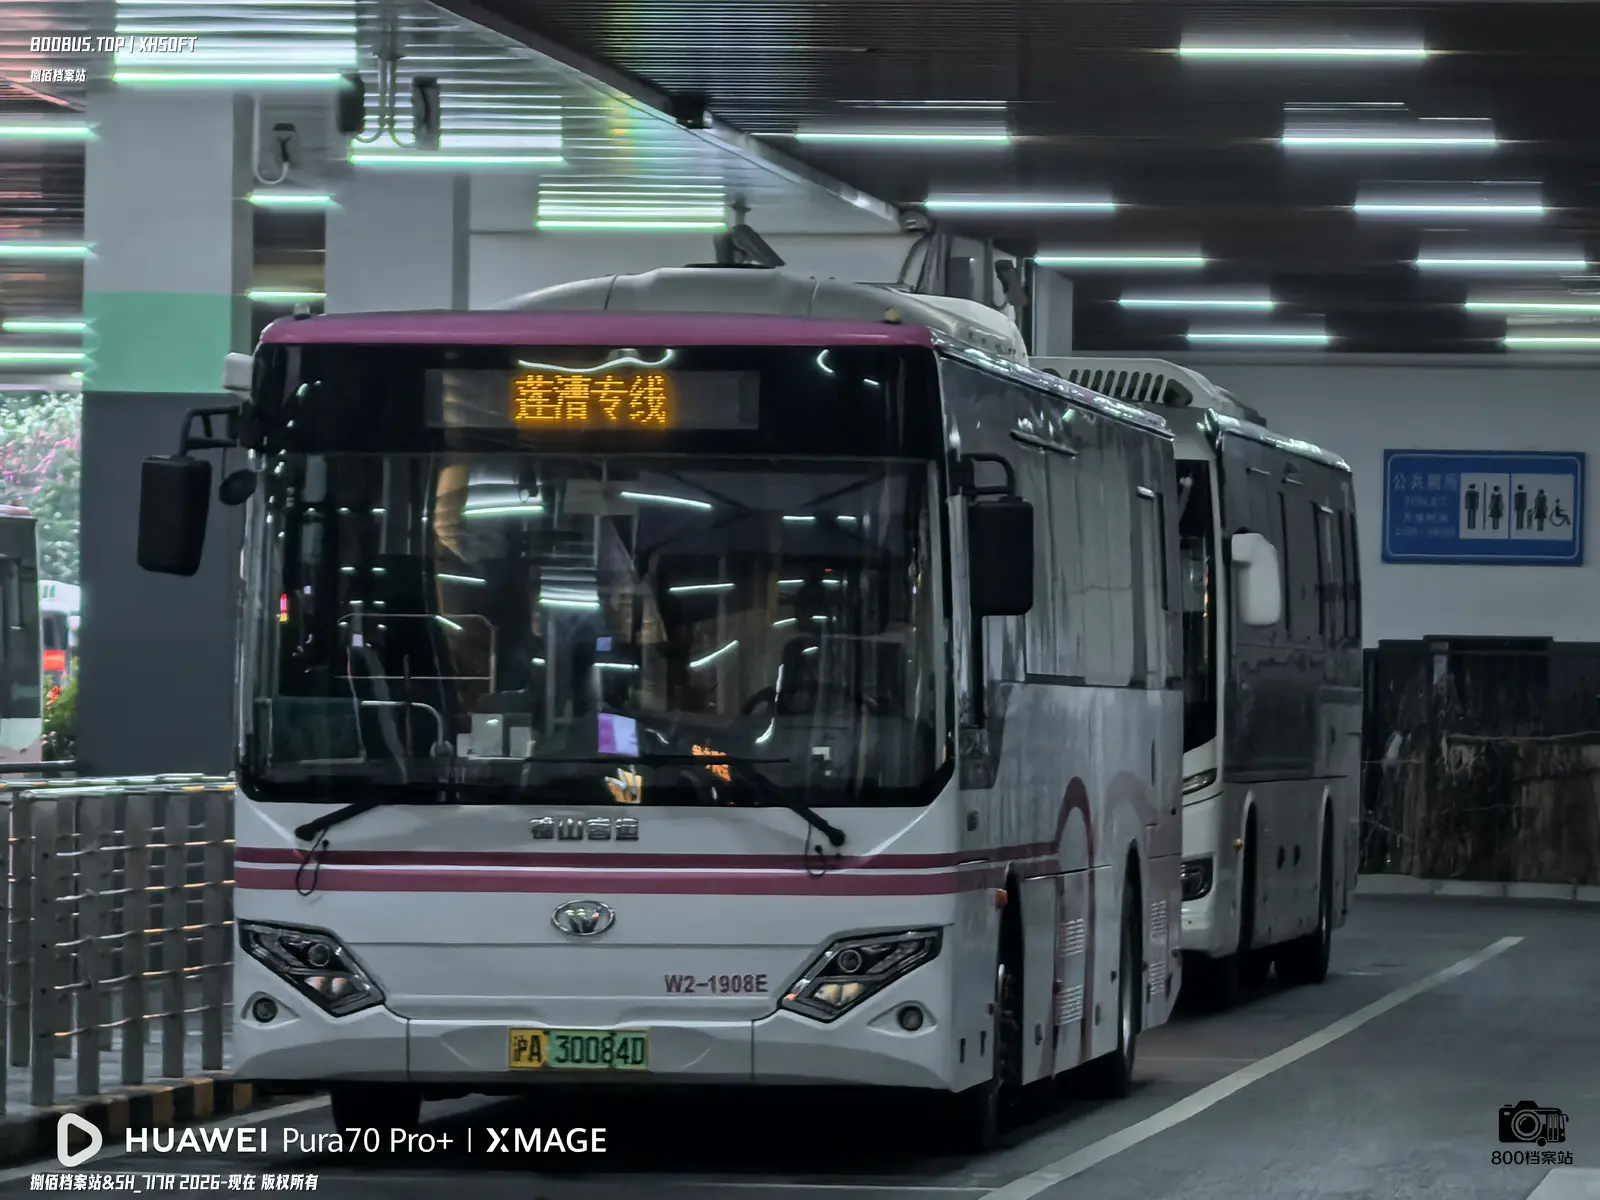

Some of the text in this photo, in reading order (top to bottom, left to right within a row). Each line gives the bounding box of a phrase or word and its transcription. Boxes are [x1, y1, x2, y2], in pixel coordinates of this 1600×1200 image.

[514, 375, 667, 423] 莲清专线
[1392, 472, 1458, 491] 公共
[664, 973, 769, 993] W2-1908E
